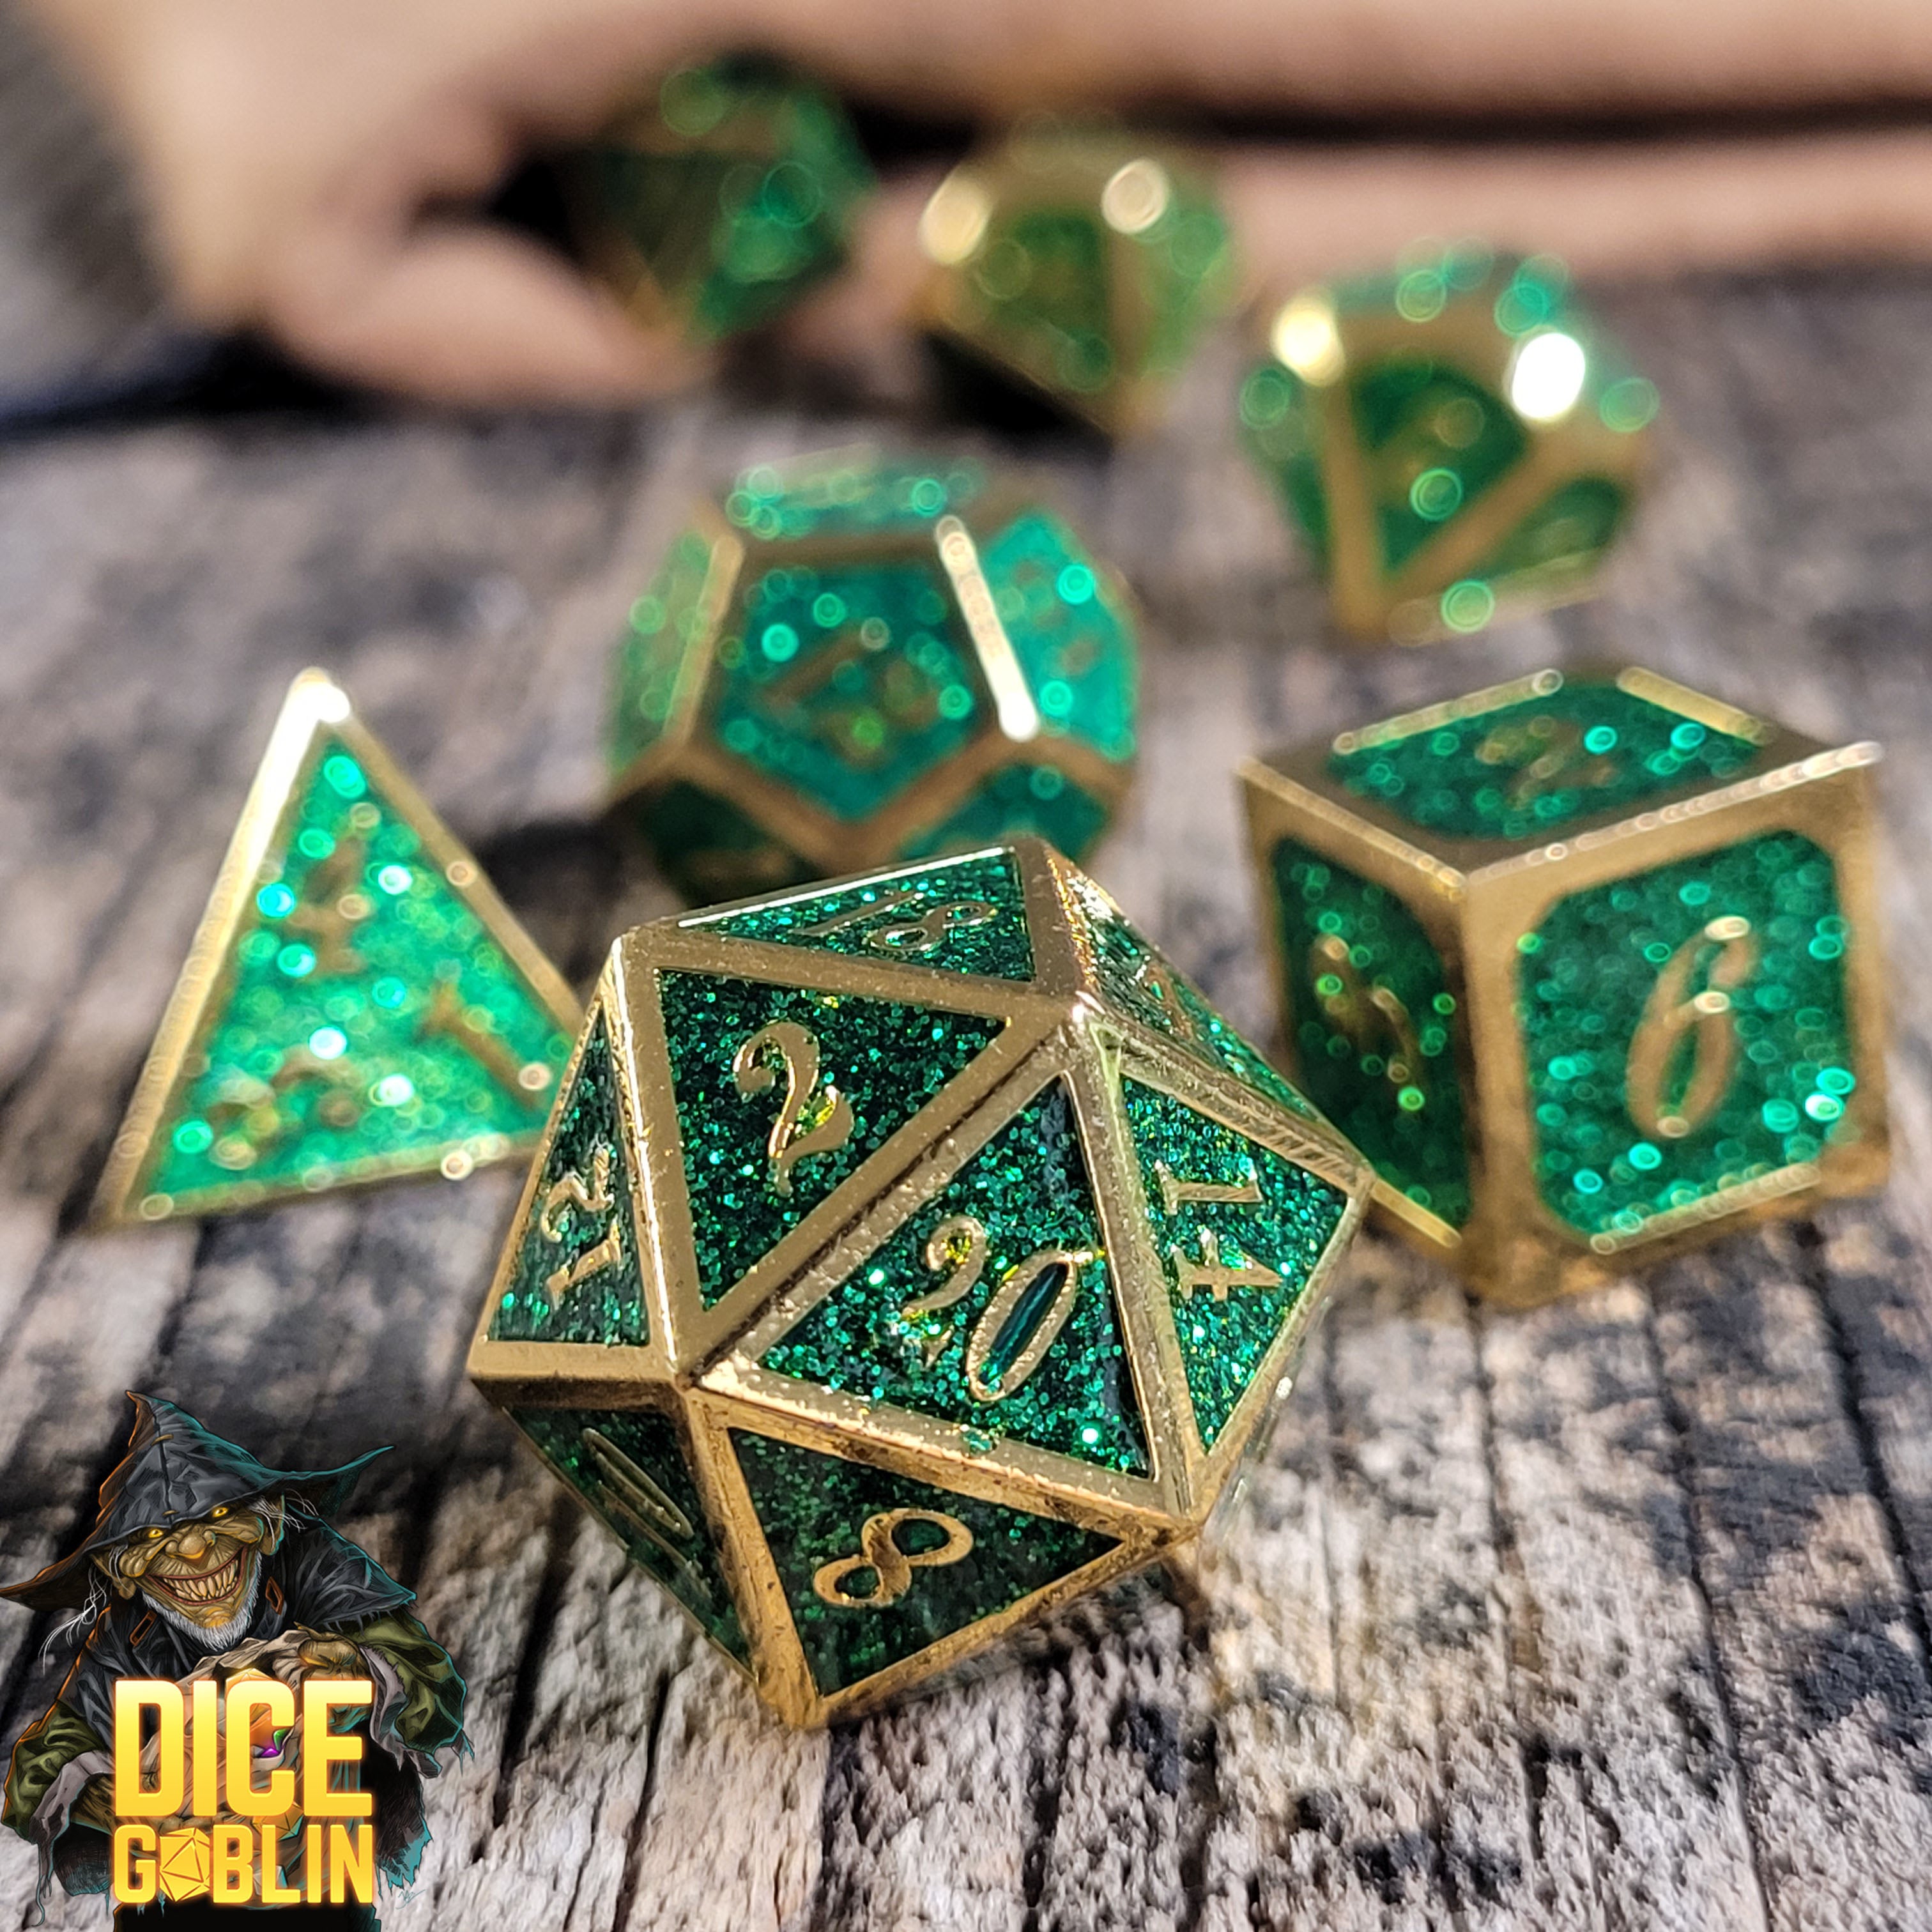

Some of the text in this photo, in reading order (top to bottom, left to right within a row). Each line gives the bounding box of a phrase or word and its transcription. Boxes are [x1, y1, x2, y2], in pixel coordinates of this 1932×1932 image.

[787, 888, 998, 952] 18
[733, 1022, 854, 1197] 2
[1627, 914, 1757, 1140] 6
[540, 1135, 624, 1310] 12
[900, 1213, 1080, 1402] 20
[1151, 1158, 1283, 1302] 14
[812, 1507, 975, 1608] 8
